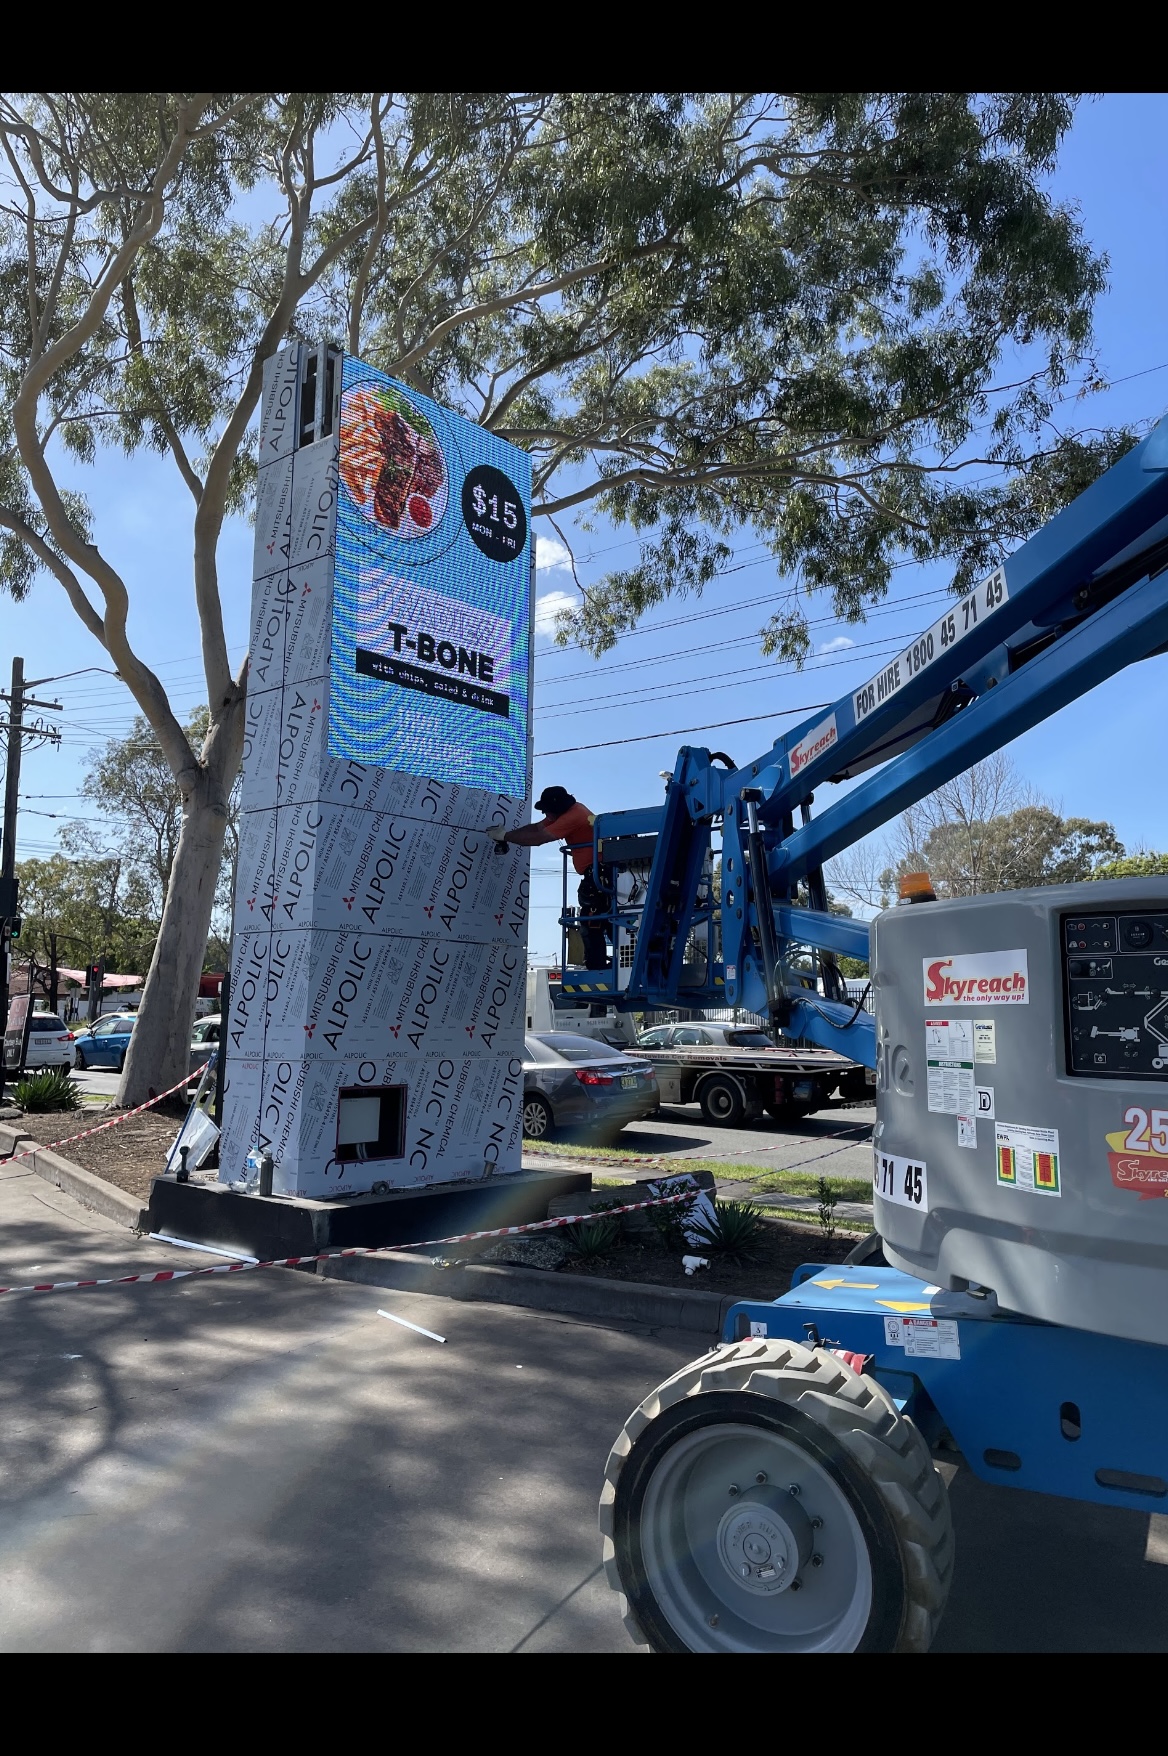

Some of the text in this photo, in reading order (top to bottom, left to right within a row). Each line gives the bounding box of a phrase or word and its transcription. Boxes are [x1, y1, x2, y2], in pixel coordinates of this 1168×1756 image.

[262, 375, 280, 434] MITSUBISHI
[269, 350, 298, 452] ALPOLIC
[272, 476, 291, 538] MITSUBISHI
[307, 445, 340, 550] ALPOLIC
[472, 484, 518, 529] $15
[472, 522, 492, 538] MON
[249, 599, 268, 660] MITSUBISHI
[256, 578, 289, 682] ALPOLIC
[285, 600, 306, 664] MITSUBISHI
[388, 622, 494, 682] T-BONE
[856, 573, 1003, 719] FOR HIRE 1800 45 71 45
[372, 662, 394, 676] with
[434, 682, 458, 695] salad
[471, 692, 494, 706] drink
[292, 716, 316, 780] MITSUBISHI
[791, 727, 836, 774] Skyreach
[252, 831, 274, 894] MITSUBISHI
[274, 828, 296, 892] MITSUBISHI
[282, 810, 323, 920] ALPOLIC
[349, 834, 376, 894] MITSUBISHI
[362, 822, 406, 924] ALPOLIC
[429, 845, 454, 904] MITSUBISHI
[440, 836, 478, 932] ALPOLIC
[500, 856, 520, 912] MITSUBISHI
[298, 920, 318, 928] ALPOLIC
[339, 923, 362, 931] ALPOLIC
[421, 930, 440, 938] ALPOLIC
[458, 934, 476, 942] ALPOLIC
[230, 940, 268, 1048] ALPOLIC
[310, 954, 340, 1021] MITSUBISHI
[322, 941, 372, 1051] ALPOLIC
[396, 960, 422, 1022] MITSUBISHI
[407, 947, 450, 1050] ALPOLIC
[470, 964, 493, 1023] MITSUBISHI
[480, 952, 518, 1050] ALPOLIC
[926, 960, 1026, 1001] Skyreach
[976, 994, 992, 1002] only
[994, 994, 1010, 1002] way
[1012, 994, 1025, 1002] up!
[266, 1062, 292, 1125] OLIC
[426, 1060, 455, 1118] OLIC
[498, 1059, 522, 1113] OLIC
[273, 1111, 295, 1169] CHEMICAL
[410, 1128, 434, 1170] NC
[436, 1103, 458, 1158] CHEMICAL
[484, 1122, 506, 1162] NC
[1124, 1106, 1168, 1154] 25
[882, 1158, 894, 1196] 71
[904, 1164, 922, 1205] 45
